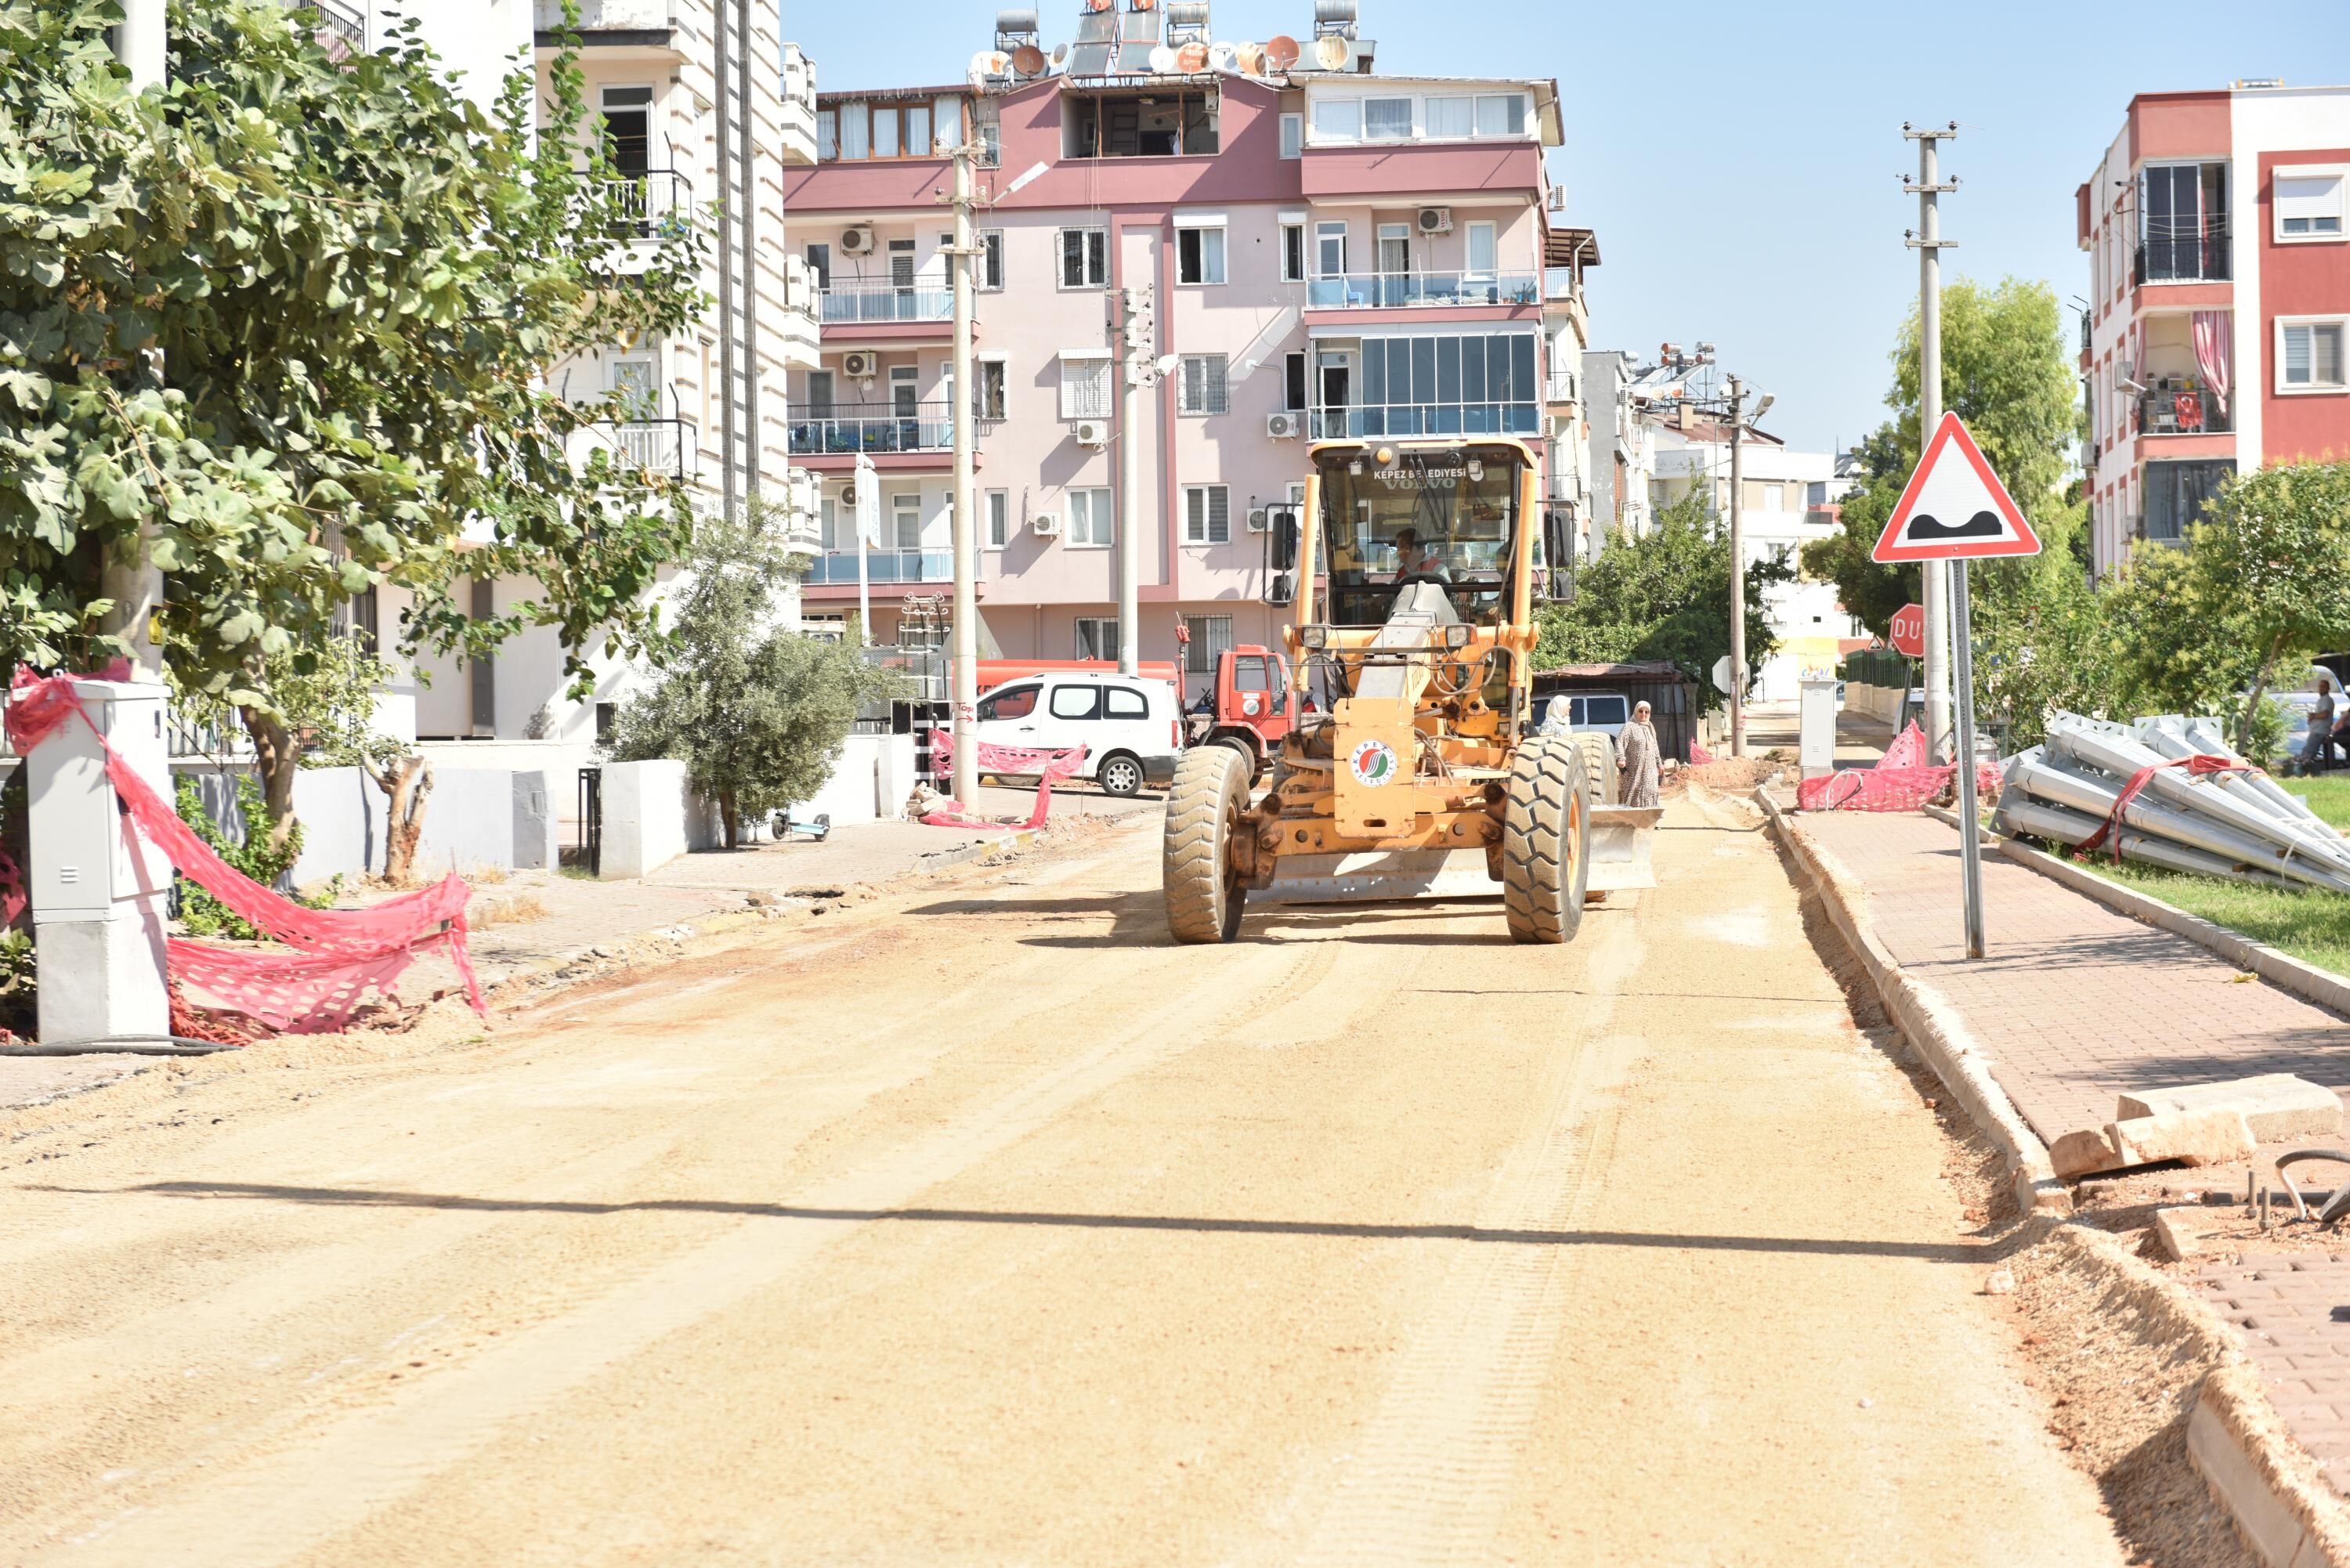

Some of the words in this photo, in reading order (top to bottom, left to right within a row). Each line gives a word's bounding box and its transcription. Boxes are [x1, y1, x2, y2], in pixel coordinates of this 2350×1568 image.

[1374, 470, 1406, 479] KEPEZ
[1408, 468, 1466, 479] BEEDİYESİ
[1382, 478, 1456, 490] VOLVO
[1894, 619, 1923, 640] DU
[1353, 742, 1387, 764] KEPEZ
